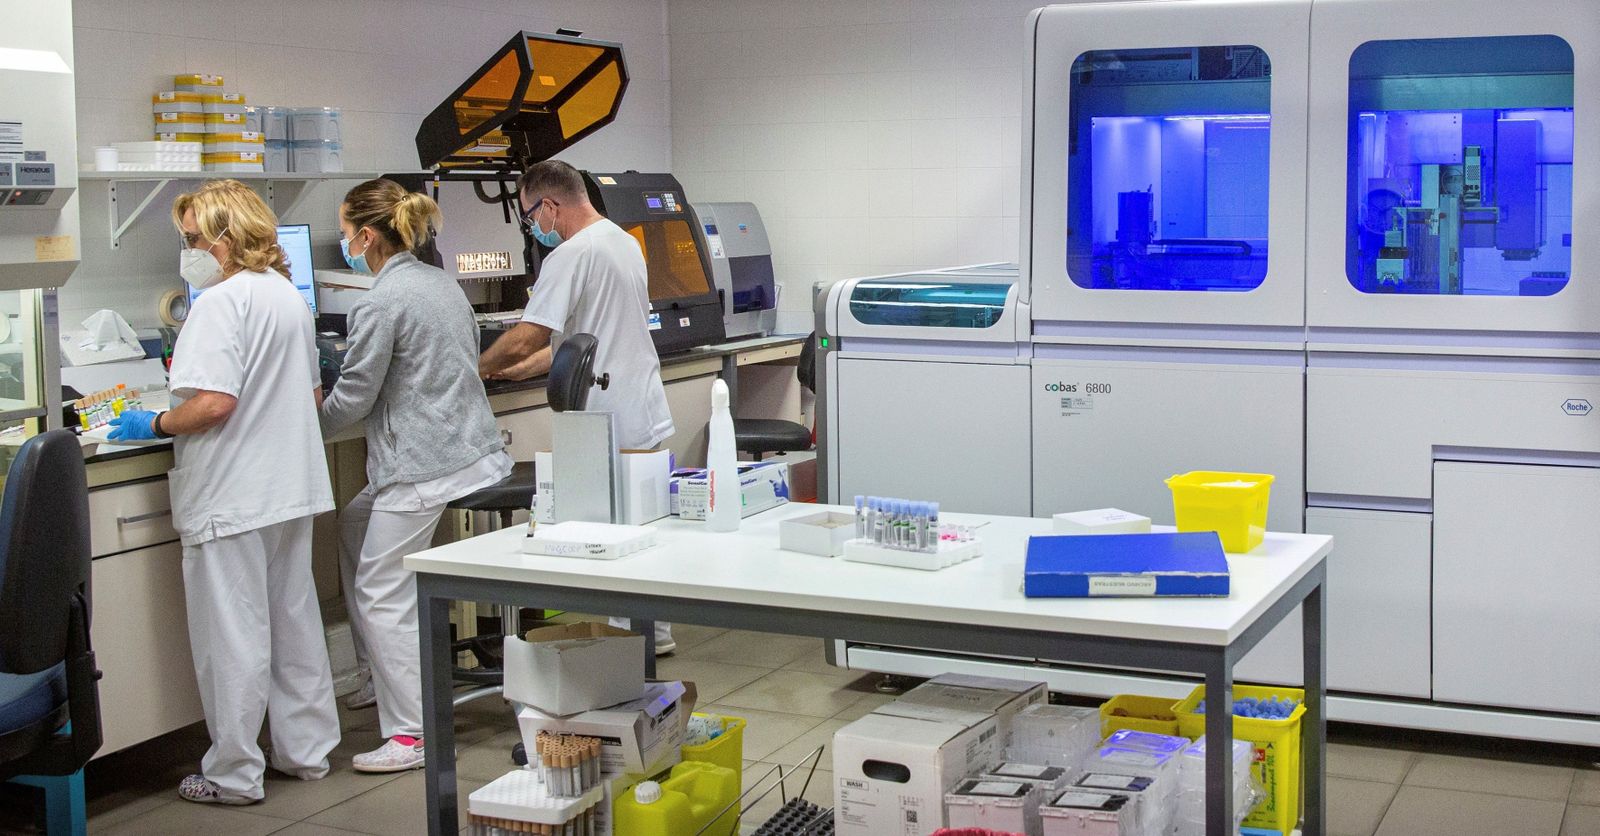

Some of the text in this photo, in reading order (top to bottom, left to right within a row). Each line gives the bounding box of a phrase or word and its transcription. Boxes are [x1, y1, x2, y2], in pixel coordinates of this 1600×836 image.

[1045, 381, 1112, 394] cobas 6800
[1566, 402, 1588, 411] Roche
